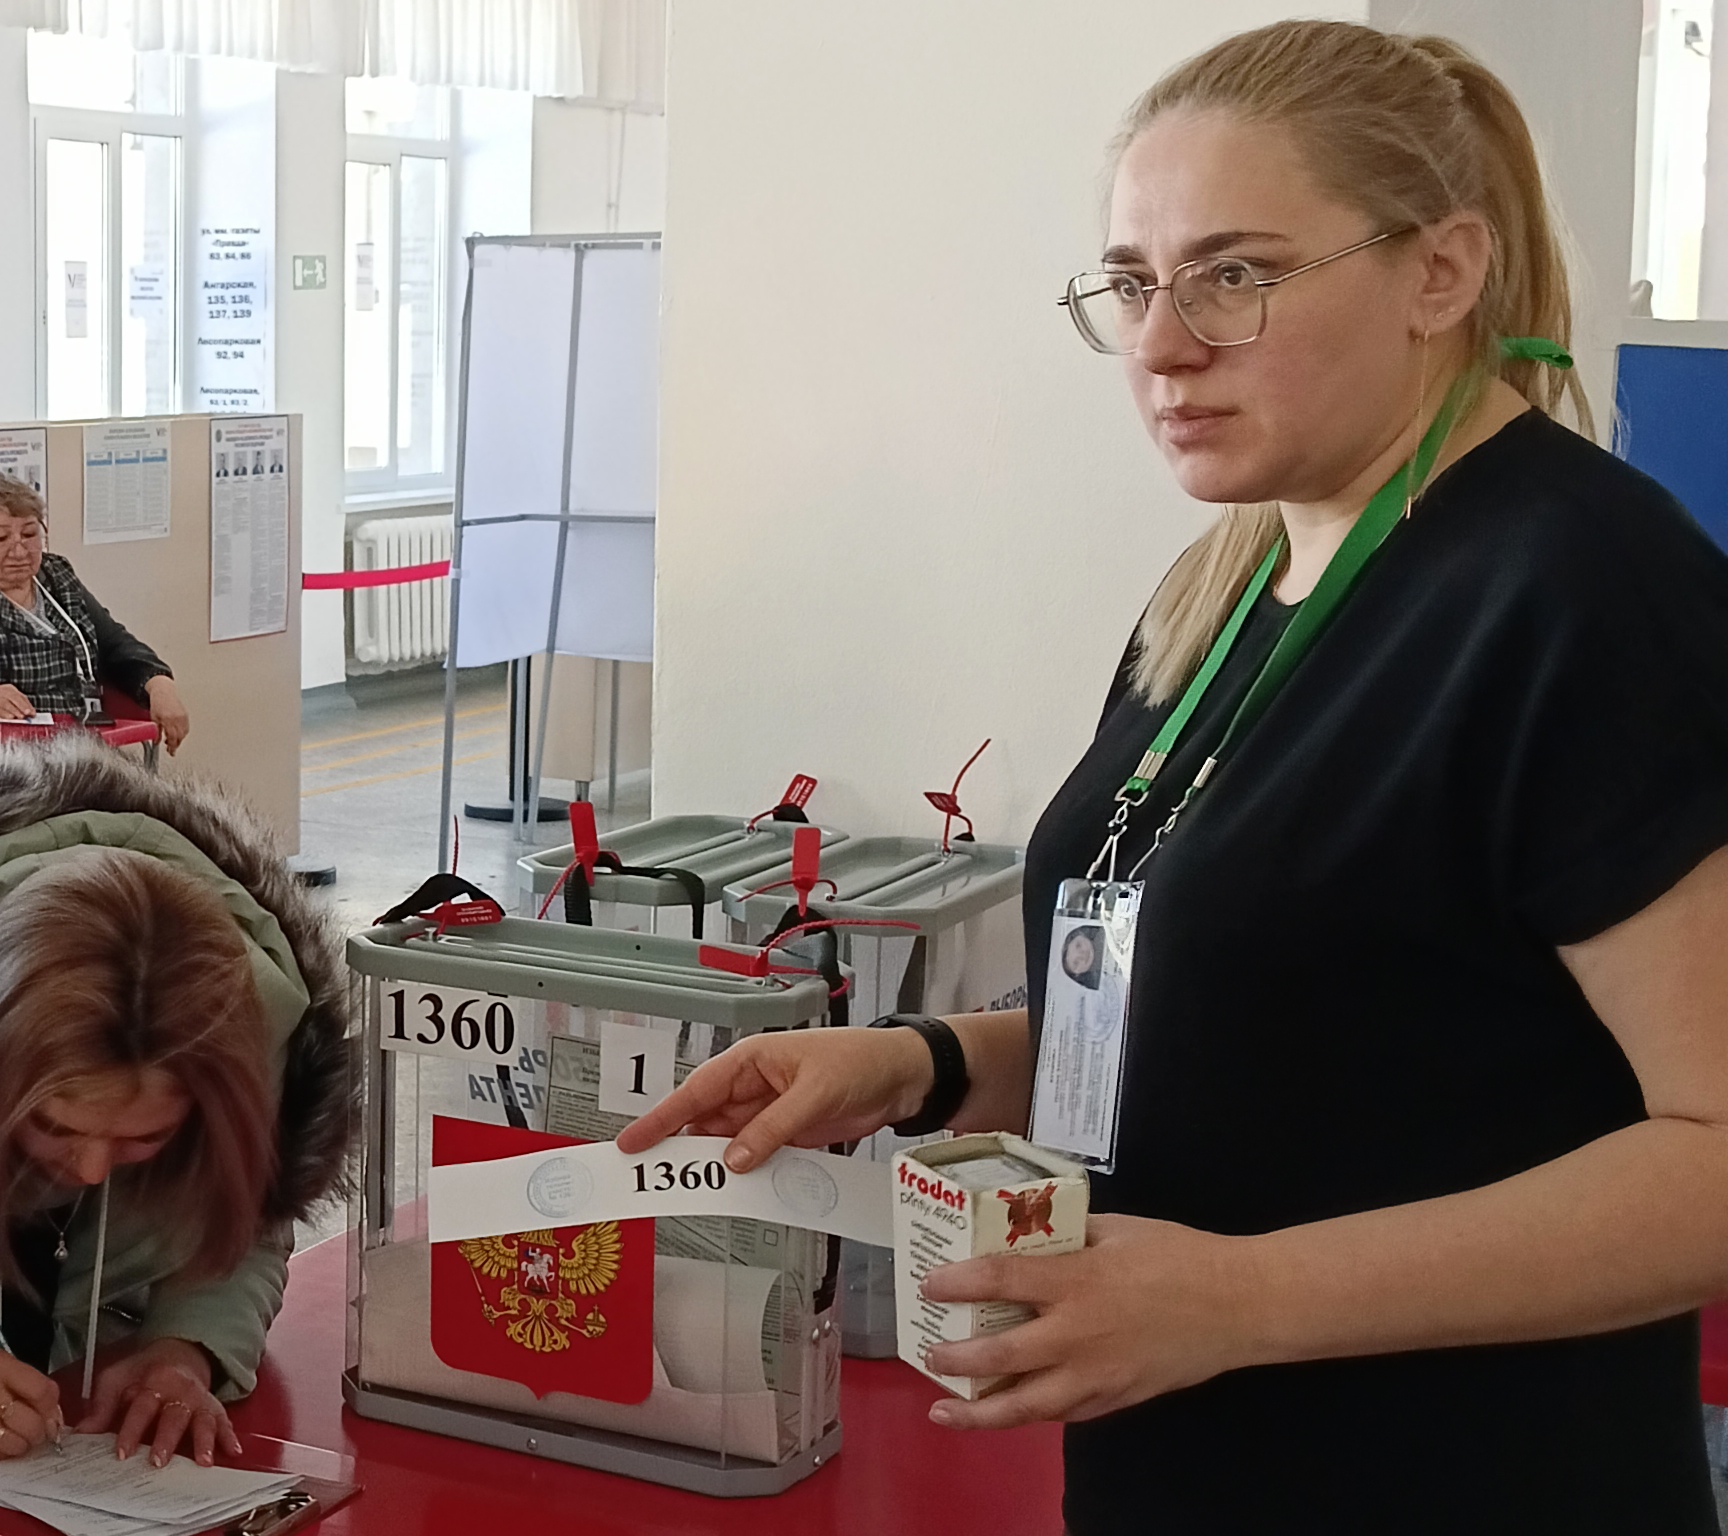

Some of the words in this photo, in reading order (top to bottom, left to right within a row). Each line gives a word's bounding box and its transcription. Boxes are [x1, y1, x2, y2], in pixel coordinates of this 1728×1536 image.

[203, 280, 257, 290] Ангарская,
[207, 295, 229, 305] 135,
[208, 309, 230, 319] 137,
[387, 989, 515, 1055] 1360
[627, 1053, 648, 1096] 1
[632, 1160, 726, 1193] 1360
[898, 1162, 967, 1212] trodat
